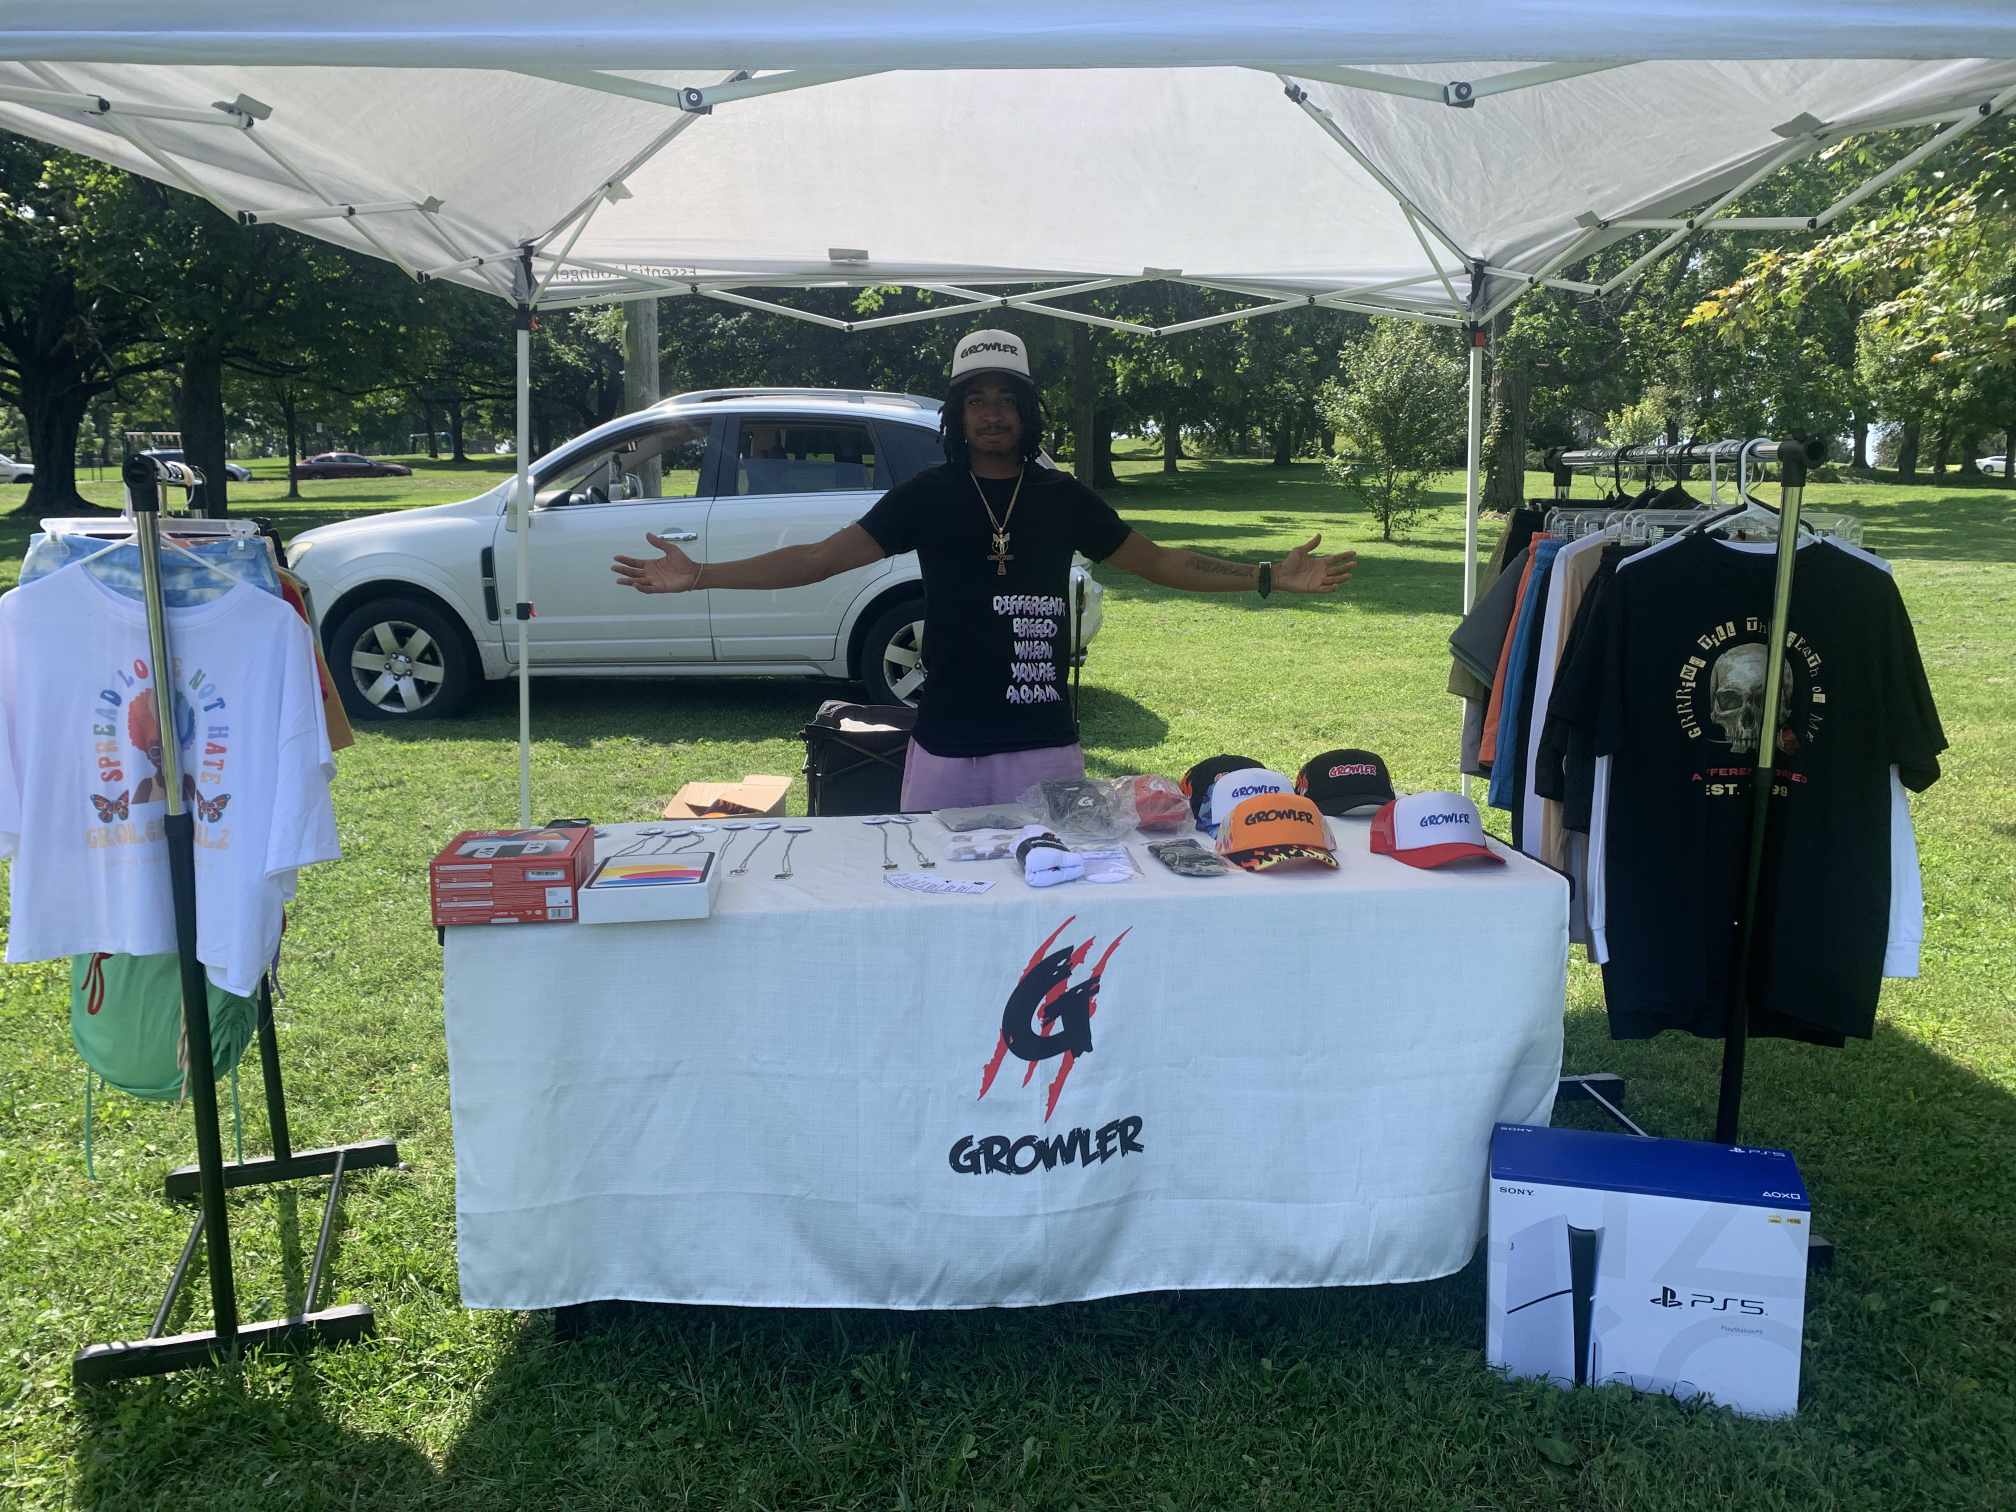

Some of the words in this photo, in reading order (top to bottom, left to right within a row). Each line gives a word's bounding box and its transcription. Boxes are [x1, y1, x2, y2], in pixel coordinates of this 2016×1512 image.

[960, 342, 1018, 359] GROWLER
[1013, 617, 1058, 638] BREED
[1013, 640, 1053, 660] WHEN
[117, 656, 184, 688] LOE
[188, 669, 226, 713] NOT
[93, 688, 124, 783] SPREAD
[200, 725, 230, 785] HATE
[1328, 764, 1377, 778] GROWLER
[1231, 785, 1280, 798] GROWLER
[1244, 809, 1314, 827] GROWLER
[1419, 812, 1470, 828] GROWLER
[1002, 944, 1101, 1062] G
[948, 1115, 1145, 1176] GROWLER
[1499, 1185, 1535, 1197] SONY
[1690, 1293, 1766, 1316] PS5
